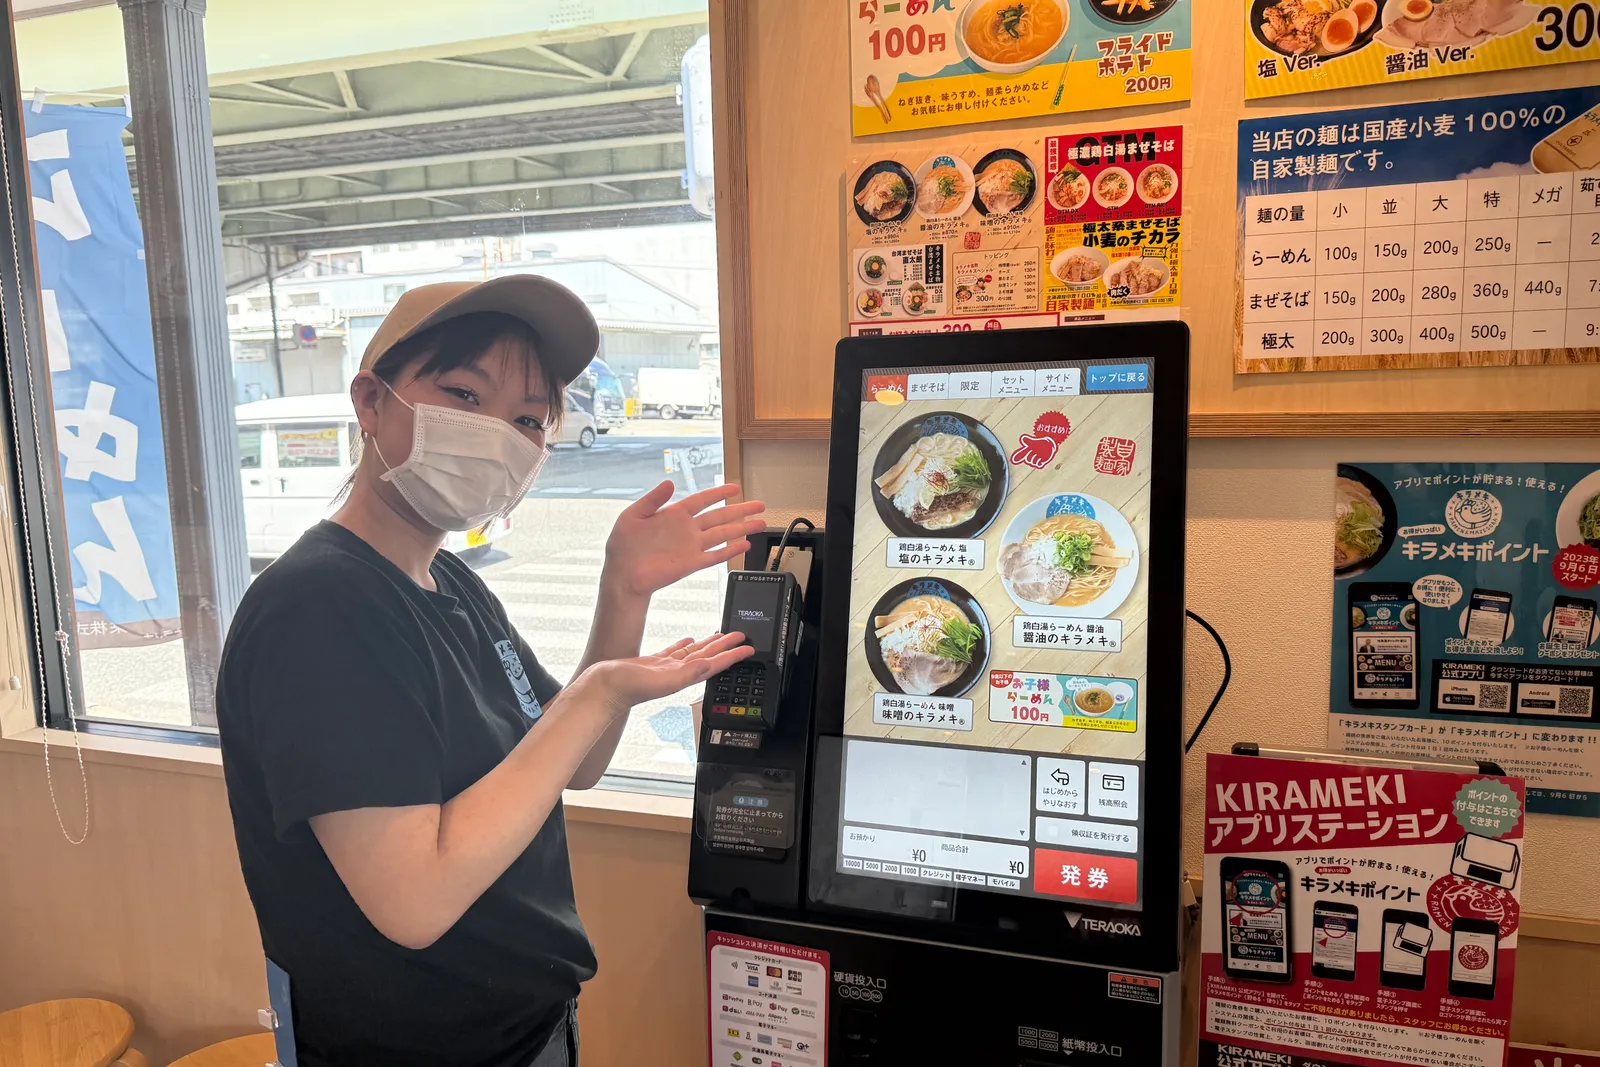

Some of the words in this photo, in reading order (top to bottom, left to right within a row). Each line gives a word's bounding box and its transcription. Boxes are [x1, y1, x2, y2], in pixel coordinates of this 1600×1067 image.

[868, 28, 946, 60] 100円
[1097, 31, 1173, 57] フライド
[1098, 55, 1152, 77] ポテト
[1257, 58, 1277, 78] 塩
[1284, 53, 1320, 73] Ver.
[1385, 50, 1428, 75] 醤油
[1435, 44, 1474, 65] Ver.
[1126, 77, 1171, 94] 200円
[911, 95, 1031, 115] お気軽にお申し付けください。
[1252, 149, 1394, 182] 自家製麺です。
[1257, 204, 1305, 224] 麺の量
[1332, 203, 1348, 219] 小
[1382, 198, 1397, 216] 並
[1432, 194, 1448, 211] 大
[1483, 190, 1500, 208] 特
[1532, 186, 1562, 204] メガ
[1082, 228, 1180, 247] 小麦のチカラ
[1251, 248, 1311, 267] らーめん
[1324, 246, 1357, 263] 100g
[1374, 242, 1407, 259] 150g
[1423, 239, 1458, 256] 200g
[1474, 236, 1511, 253] 250g
[1249, 290, 1310, 310] まぜそば
[1323, 290, 1356, 306] 150g
[1371, 287, 1405, 304] 200g
[1421, 285, 1456, 301] 280g
[1472, 282, 1509, 299] 360g
[1524, 280, 1562, 296] 440g
[1046, 298, 1095, 311] 自家製麺
[1261, 332, 1294, 350] 極太
[1321, 331, 1355, 347] 200g
[1369, 328, 1404, 345] 300g
[1419, 326, 1454, 342] 400g
[1470, 324, 1506, 340] 500g
[1002, 375, 1025, 385] セット
[1046, 373, 1070, 383] サイド
[1090, 371, 1146, 385] トップに戻る
[871, 383, 904, 394] らーめん
[910, 381, 945, 393] まぜそば
[960, 380, 980, 392] 限定
[998, 385, 1028, 395] メニュー
[1042, 384, 1073, 394] メニュー
[1455, 489, 1490, 500] キラメキ
[899, 543, 956, 553] 鶏白湯らーめん
[959, 544, 968, 553] 塩
[1402, 540, 1549, 564] キラメキポイント
[1562, 552, 1599, 567] 2023年
[1560, 562, 1599, 575] 9月6日
[1561, 571, 1592, 584] スタート
[1023, 621, 1083, 634] 鶏白湯らーめん
[1086, 624, 1104, 634] 醤油
[1442, 662, 1485, 671] KIRAMEKI
[1442, 670, 1485, 680] 公式アプリ
[1012, 678, 1050, 692] お子様
[882, 700, 937, 712] 鶏白湯らーめん
[939, 702, 955, 712] 味噌
[1007, 692, 1054, 705] らーめん
[1011, 705, 1049, 722] 100円
[1043, 787, 1079, 799] はじめから
[1215, 774, 1406, 812] KIRAMEKI
[1467, 788, 1507, 803] ポイントの
[1043, 799, 1078, 811] やりなおす
[1098, 798, 1129, 810] 残高照会
[1455, 799, 1517, 819] 付与はこちらで
[1208, 808, 1448, 847] アプリステーション
[1468, 815, 1500, 829] できます
[849, 833, 876, 844] お預かり
[1072, 828, 1130, 844] 領収証を発行する
[911, 848, 926, 863] ¥0
[941, 843, 970, 855] 商品合計
[845, 860, 861, 868] 10000
[865, 863, 879, 871] 5000
[884, 865, 898, 873] 2000
[904, 867, 917, 875] 1000
[922, 869, 951, 880] クレジット
[955, 873, 984, 884] 電子マネー
[992, 878, 1016, 888] モバイル
[1009, 860, 1025, 875] ¥0
[1300, 876, 1420, 904] キラメキポイント
[1082, 918, 1141, 937] TERAOKA
[1246, 931, 1268, 942] MENU
[833, 971, 887, 989] 硬貨投入口
[1062, 1038, 1122, 1057] 紙幣投入口
[1218, 1045, 1292, 1065] KIRAMEKI
